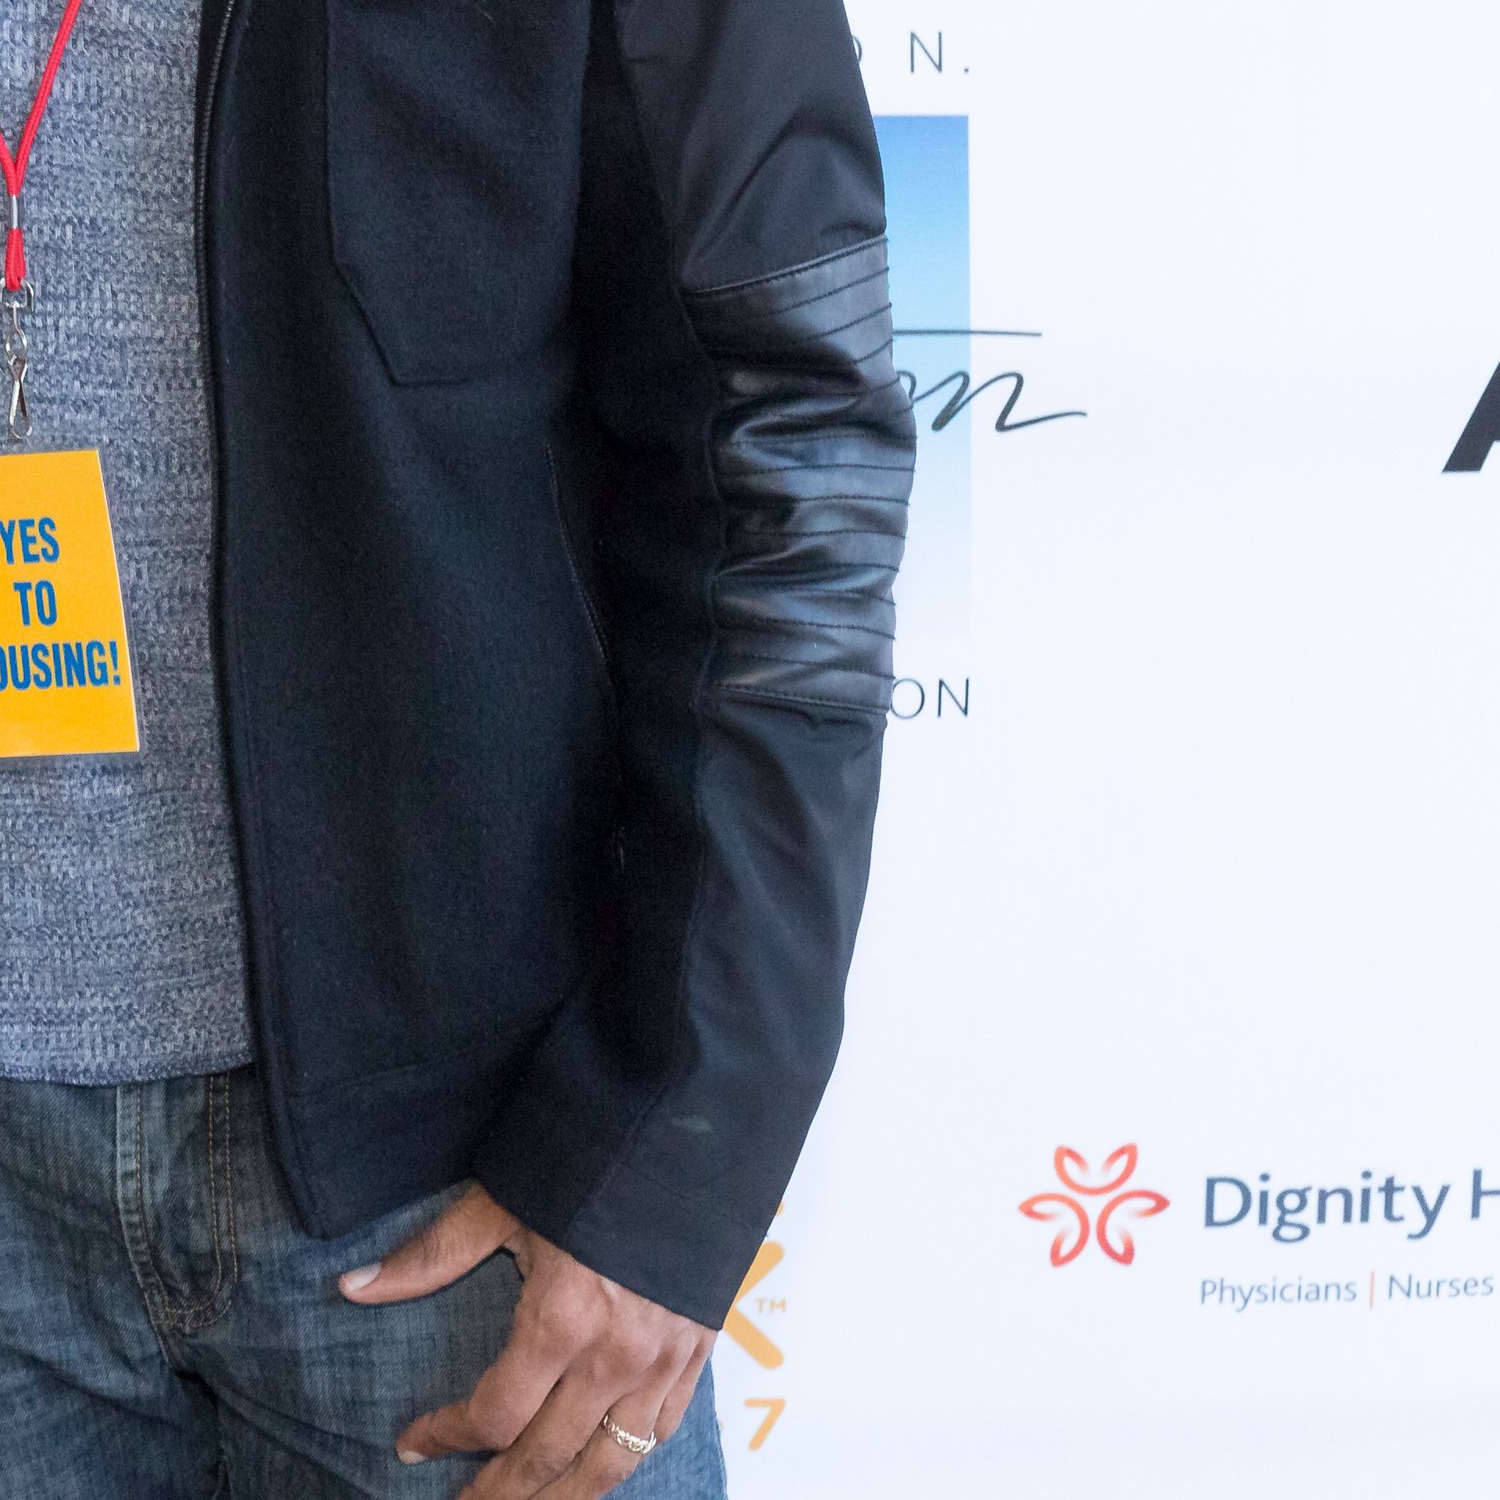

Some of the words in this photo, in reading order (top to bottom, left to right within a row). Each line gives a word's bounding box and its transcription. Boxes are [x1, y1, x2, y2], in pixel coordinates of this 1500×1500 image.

[909, 30, 970, 74] N.
[12, 579, 59, 627] TO
[1203, 1169, 1452, 1244] Dignity
[1199, 1275, 1358, 1313] Physicians
[1387, 1273, 1495, 1300] Nurses
